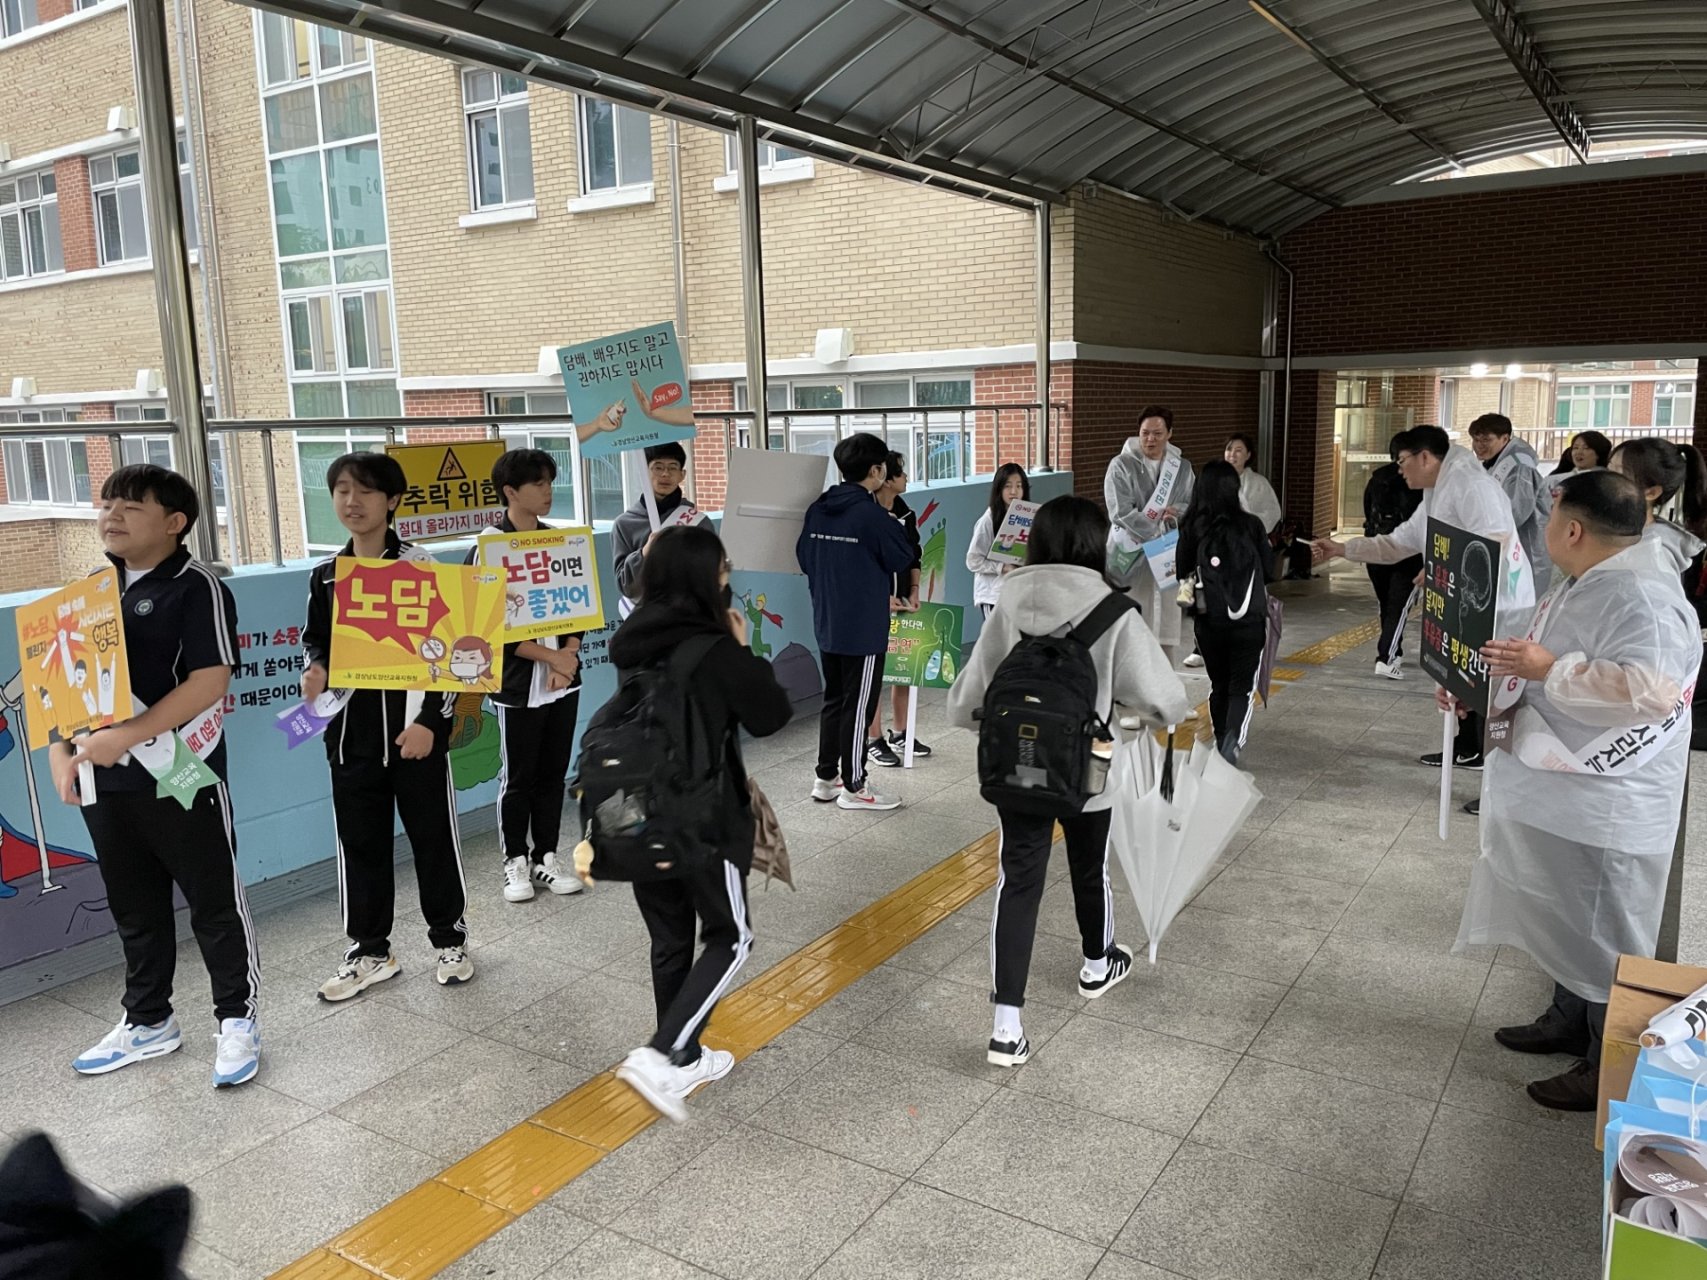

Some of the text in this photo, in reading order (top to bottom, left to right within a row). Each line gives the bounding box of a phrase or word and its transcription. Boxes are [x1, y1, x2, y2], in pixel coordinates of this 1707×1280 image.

[563, 332, 670, 371] 담배, 배우지도 말고
[578, 354, 663, 388] 권하지도 맙시다
[668, 387, 680, 397] No!
[403, 482, 451, 513] 추락
[399, 511, 503, 538] 절대 올라가지 마세요
[533, 535, 565, 545] SMOKING
[1434, 533, 1450, 561] 담배!
[502, 550, 583, 585] 노담이면
[1426, 560, 1434, 580] 그
[346, 578, 437, 628] 노담
[528, 585, 590, 619] 좋겠어
[1425, 587, 1446, 621] 달지만
[93, 618, 120, 653] 행복
[272, 625, 304, 647] 소중
[170, 762, 197, 786] 양산교육
